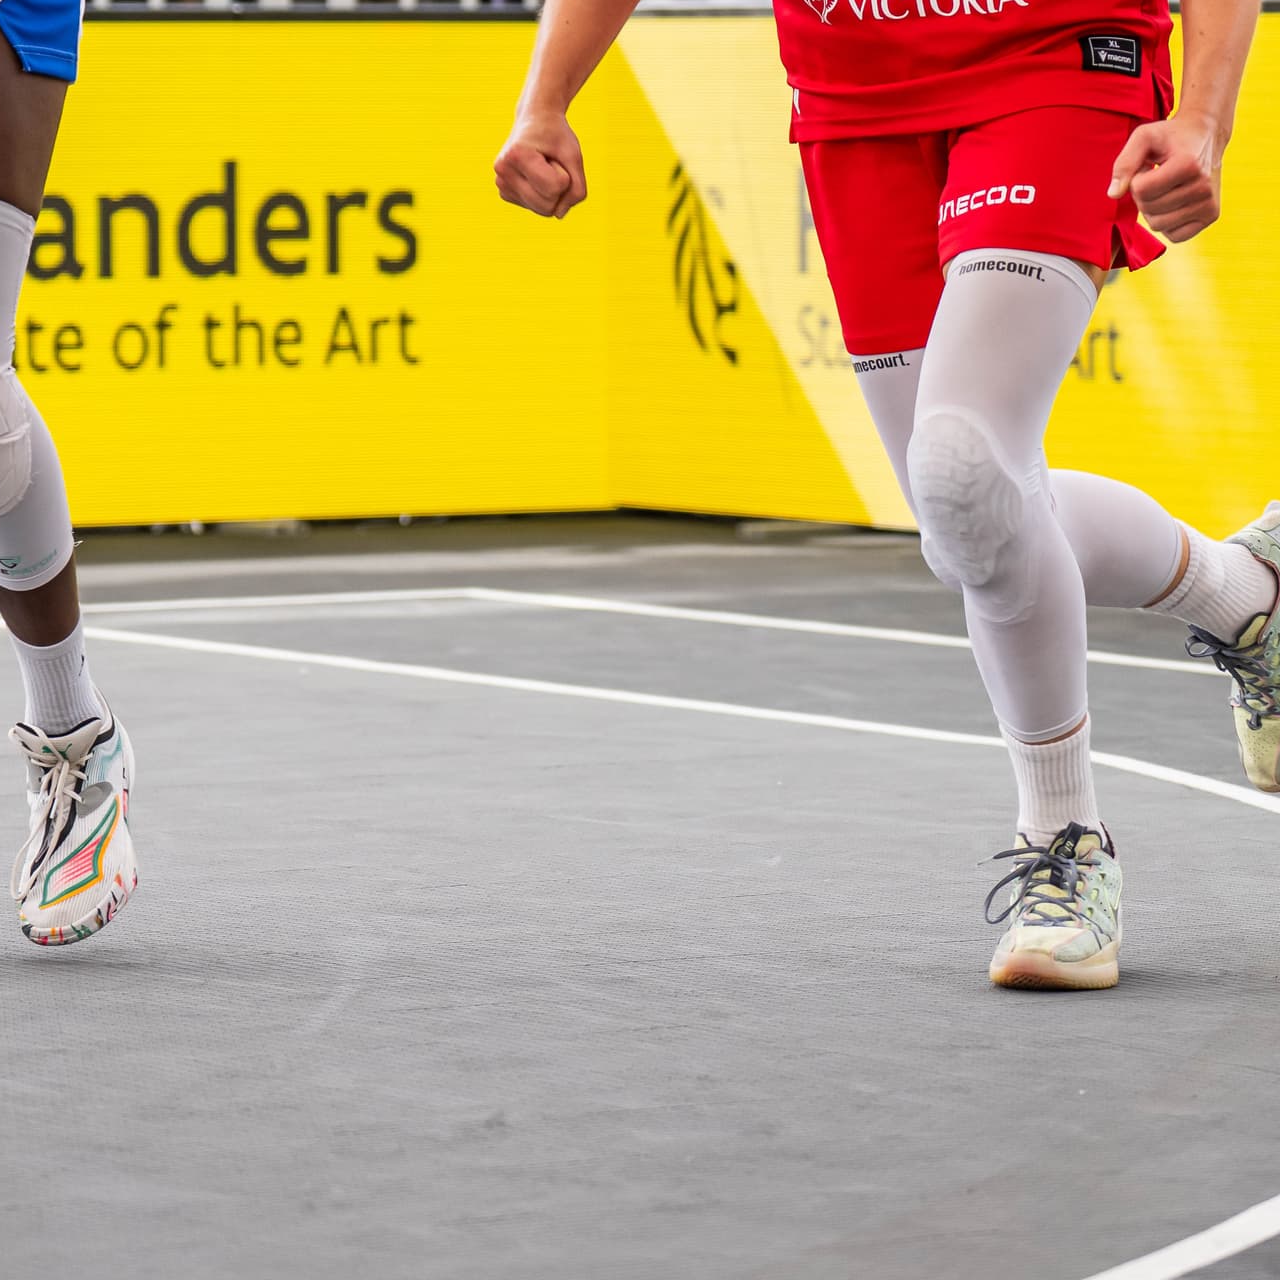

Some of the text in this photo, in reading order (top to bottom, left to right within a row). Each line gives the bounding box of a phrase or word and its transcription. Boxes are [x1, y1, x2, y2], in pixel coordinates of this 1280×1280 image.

[1108, 39, 1121, 49] XL
[26, 159, 418, 281] anders
[113, 303, 178, 371] of
[204, 303, 303, 369] the
[325, 305, 420, 366] Art
[853, 353, 911, 373] mecourt.
